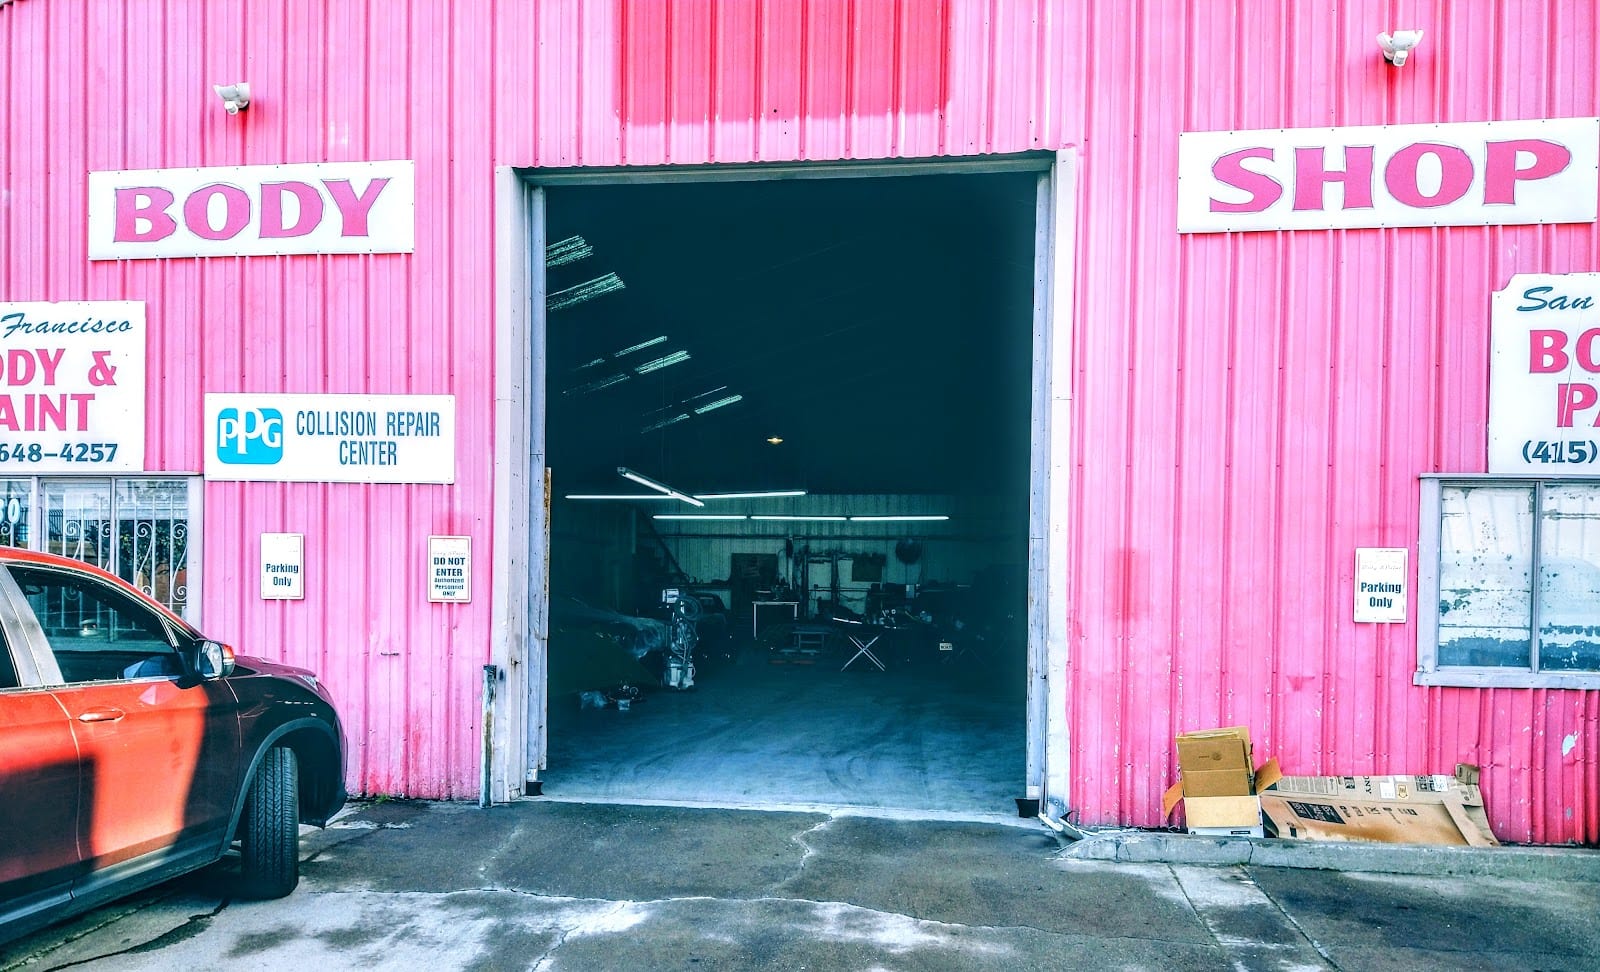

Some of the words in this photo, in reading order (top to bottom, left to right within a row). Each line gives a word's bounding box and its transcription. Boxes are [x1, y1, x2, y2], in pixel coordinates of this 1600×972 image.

[1208, 139, 1573, 214] SHOP
[112, 176, 394, 243] BODY
[1516, 286, 1595, 312] San
[0, 312, 133, 339] Francisco
[0, 348, 66, 386] DY
[88, 350, 117, 387] &
[1556, 383, 1600, 428] P
[219, 407, 282, 455] PPG
[296, 410, 377, 436] COLLISION
[386, 411, 440, 437] REPAIR
[339, 440, 397, 466] CENTER
[1522, 440, 1598, 464] (415)
[265, 563, 299, 574] Parking
[433, 557, 446, 566] DO
[447, 557, 466, 566] NOT
[436, 568, 463, 577] ENTER
[273, 576, 292, 587] Only
[1360, 581, 1402, 594] Parking
[1369, 596, 1393, 609] Only
